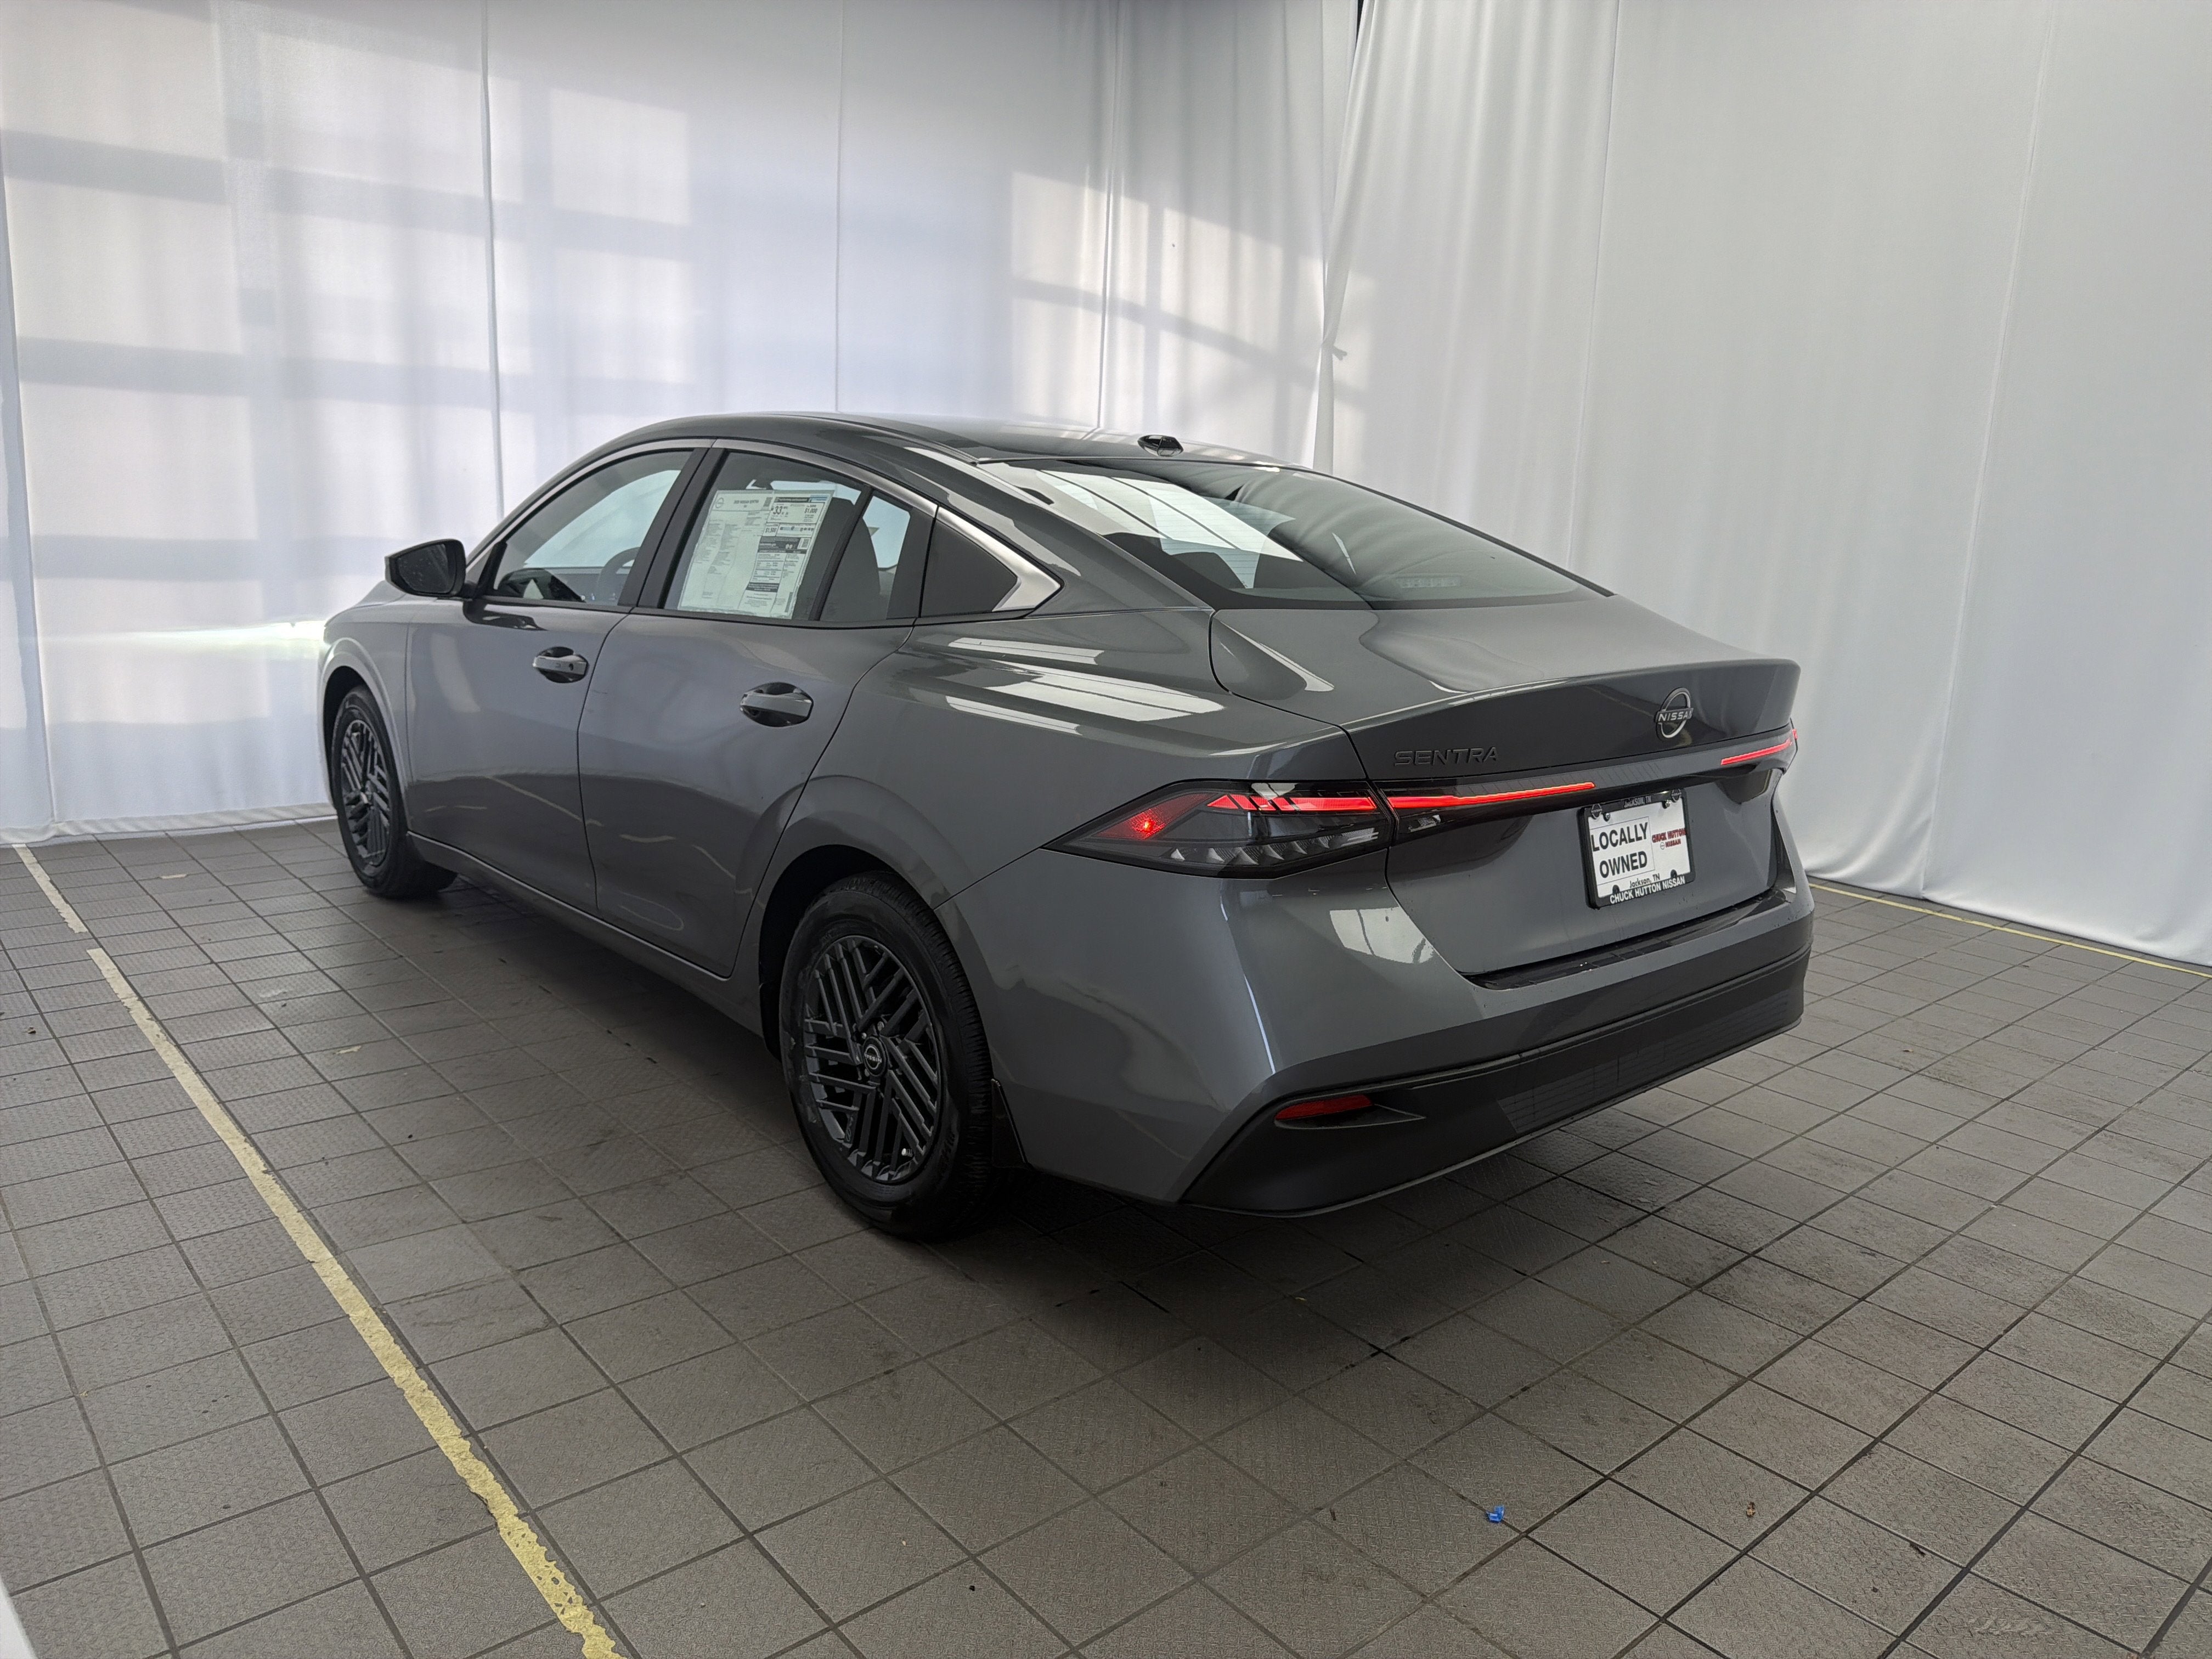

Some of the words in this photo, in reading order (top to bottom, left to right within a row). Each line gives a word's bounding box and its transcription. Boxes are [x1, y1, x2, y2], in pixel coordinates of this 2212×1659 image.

[772, 506, 783, 515] 33
[1658, 710, 1692, 721] NISSAN
[1394, 746, 1498, 766] SENTRA
[1624, 798, 1645, 808] JACKSON,
[1591, 822, 1648, 852] LOCALLY
[1651, 832, 1667, 843] CHUCK
[1667, 828, 1687, 839] HUTTON
[1665, 839, 1681, 848] NISSAN
[1599, 850, 1647, 879] OWNED
[1629, 877, 1651, 888] Jackson,
[1652, 873, 1660, 882] TN
[1610, 889, 1634, 904] CHUCK
[1635, 882, 1662, 898] HUTTON
[1662, 876, 1685, 891] NISSAN
